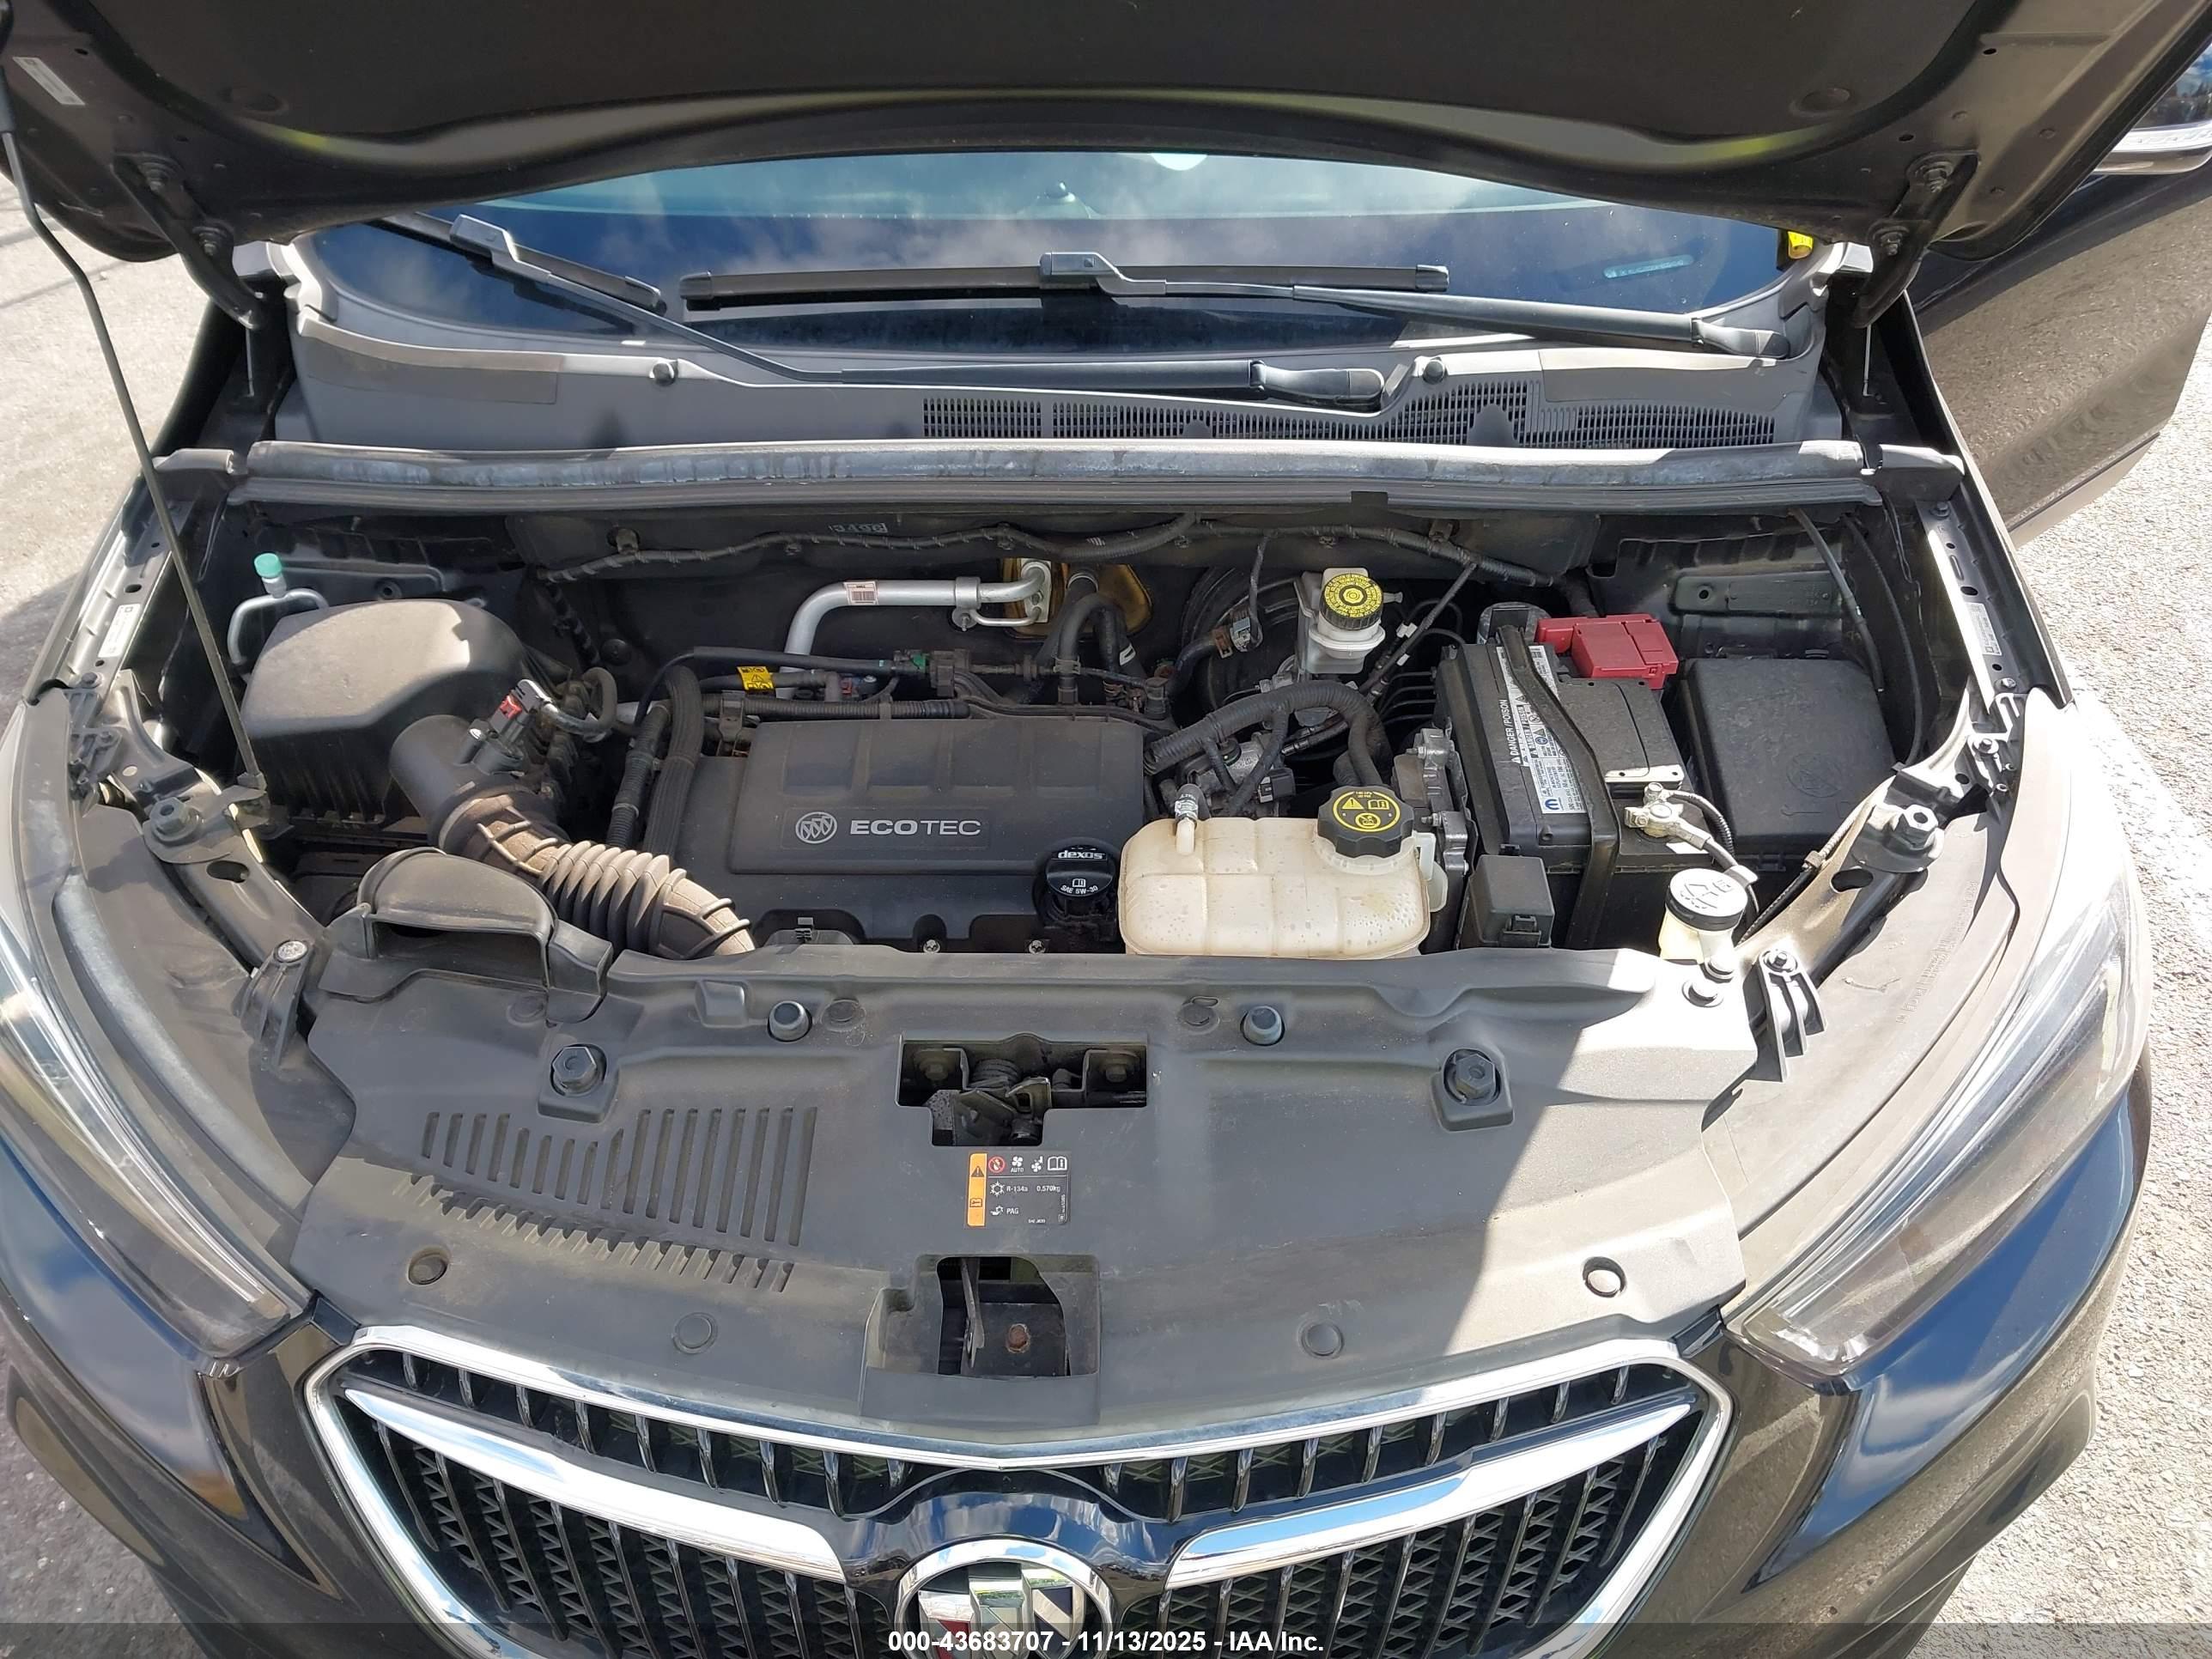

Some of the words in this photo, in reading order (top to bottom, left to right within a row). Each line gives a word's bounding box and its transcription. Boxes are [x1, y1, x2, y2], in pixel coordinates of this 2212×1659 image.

[850, 820, 981, 836] ECOTEC
[1058, 850, 1103, 860] dexos
[1060, 885, 1073, 894] SAE
[1075, 885, 1098, 894] 5W-30
